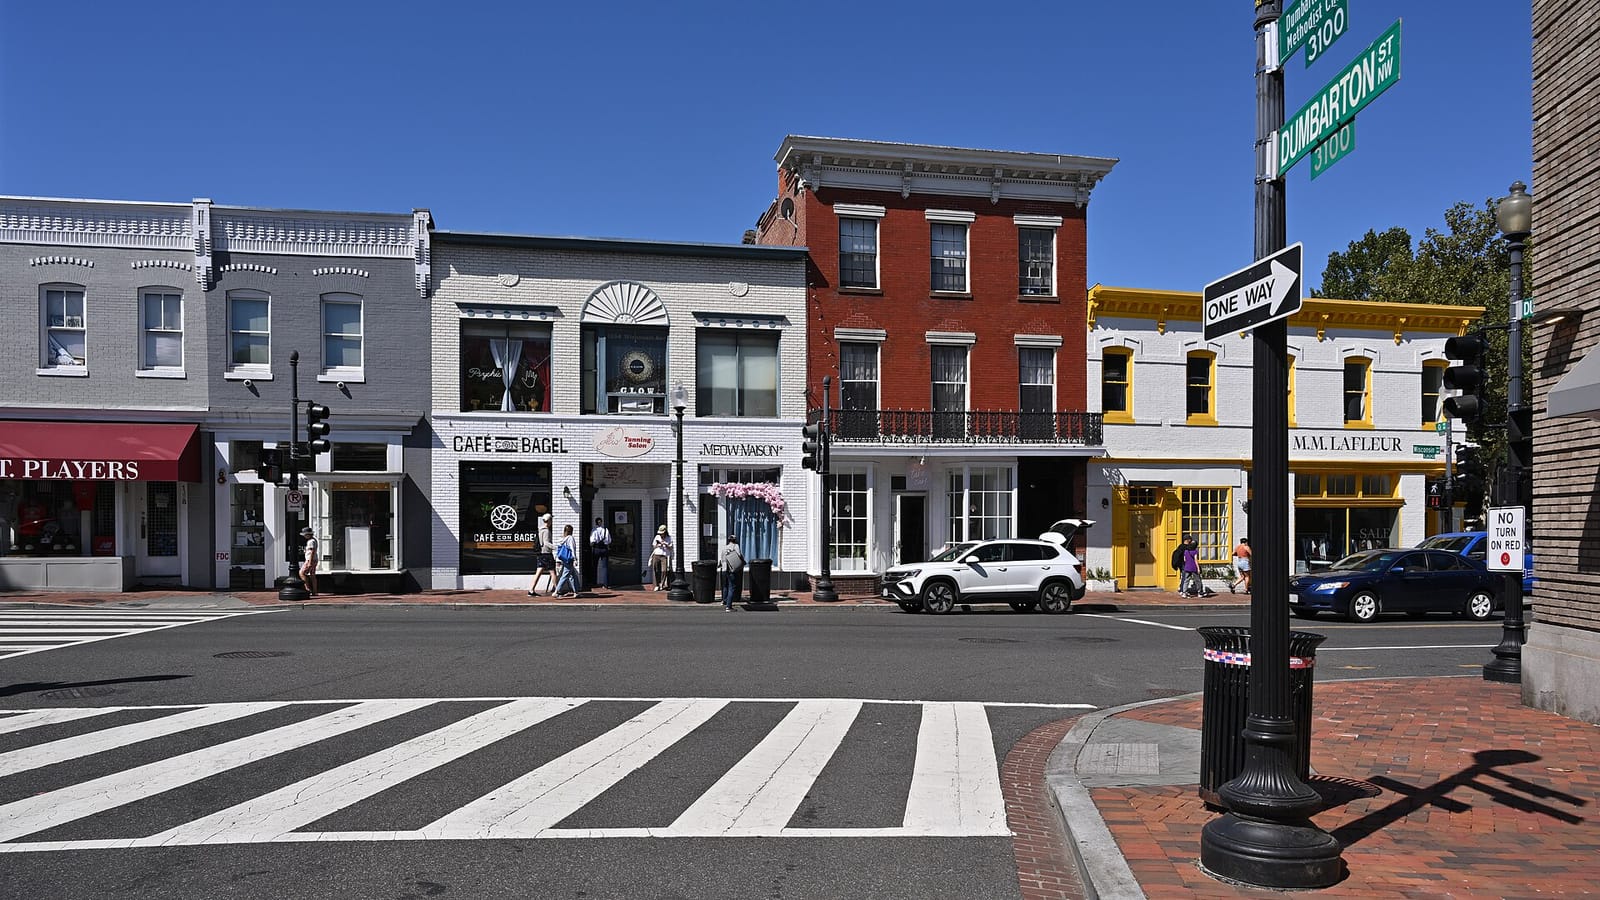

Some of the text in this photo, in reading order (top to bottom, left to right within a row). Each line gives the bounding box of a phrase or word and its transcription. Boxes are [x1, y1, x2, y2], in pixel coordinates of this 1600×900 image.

[1286, 0, 1318, 33] Dumbar
[1287, 2, 1322, 51] Methodist
[1308, 7, 1344, 61] 3100
[1378, 34, 1394, 63] ST
[1377, 56, 1394, 85] NW
[1281, 50, 1375, 168] DUMBARTON
[1314, 125, 1350, 171] 3100
[1208, 278, 1275, 320] ONE WAY
[620, 386, 655, 394] GLOW
[453, 433, 492, 452] CAFÉ
[521, 437, 568, 453] BAGEL
[623, 436, 652, 444] Tanning
[1292, 435, 1402, 451] M.M. LAFLEUR
[703, 443, 779, 457] MEOW MAISON
[22, 460, 139, 480] PLAYERS
[1498, 512, 1514, 524] NO
[473, 532, 494, 542] CAFÉ
[1359, 527, 1391, 539] SALE
[1495, 527, 1516, 537] TURN
[1490, 540, 1521, 550] ON RED
[216, 552, 229, 560] FDC
